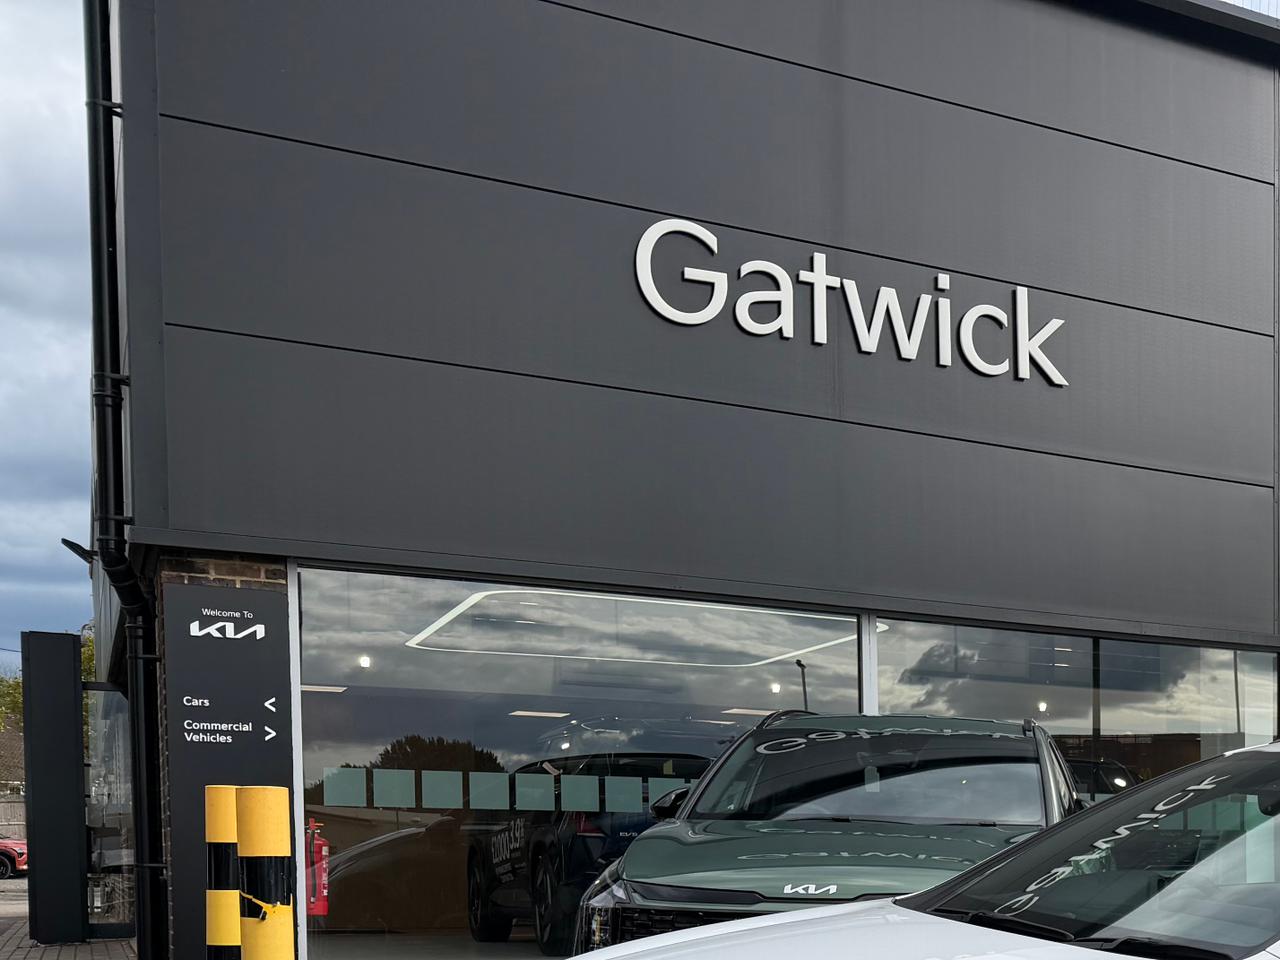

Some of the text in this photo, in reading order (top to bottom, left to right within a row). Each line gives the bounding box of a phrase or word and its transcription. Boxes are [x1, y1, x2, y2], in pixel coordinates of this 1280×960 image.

[634, 218, 1069, 387] Gatwick
[201, 608, 254, 619] Welcome To
[189, 620, 266, 640] KIA
[183, 696, 210, 707] Cars
[183, 719, 253, 732] Commercial
[184, 732, 233, 743] Vehicles
[783, 883, 838, 894] KIA
